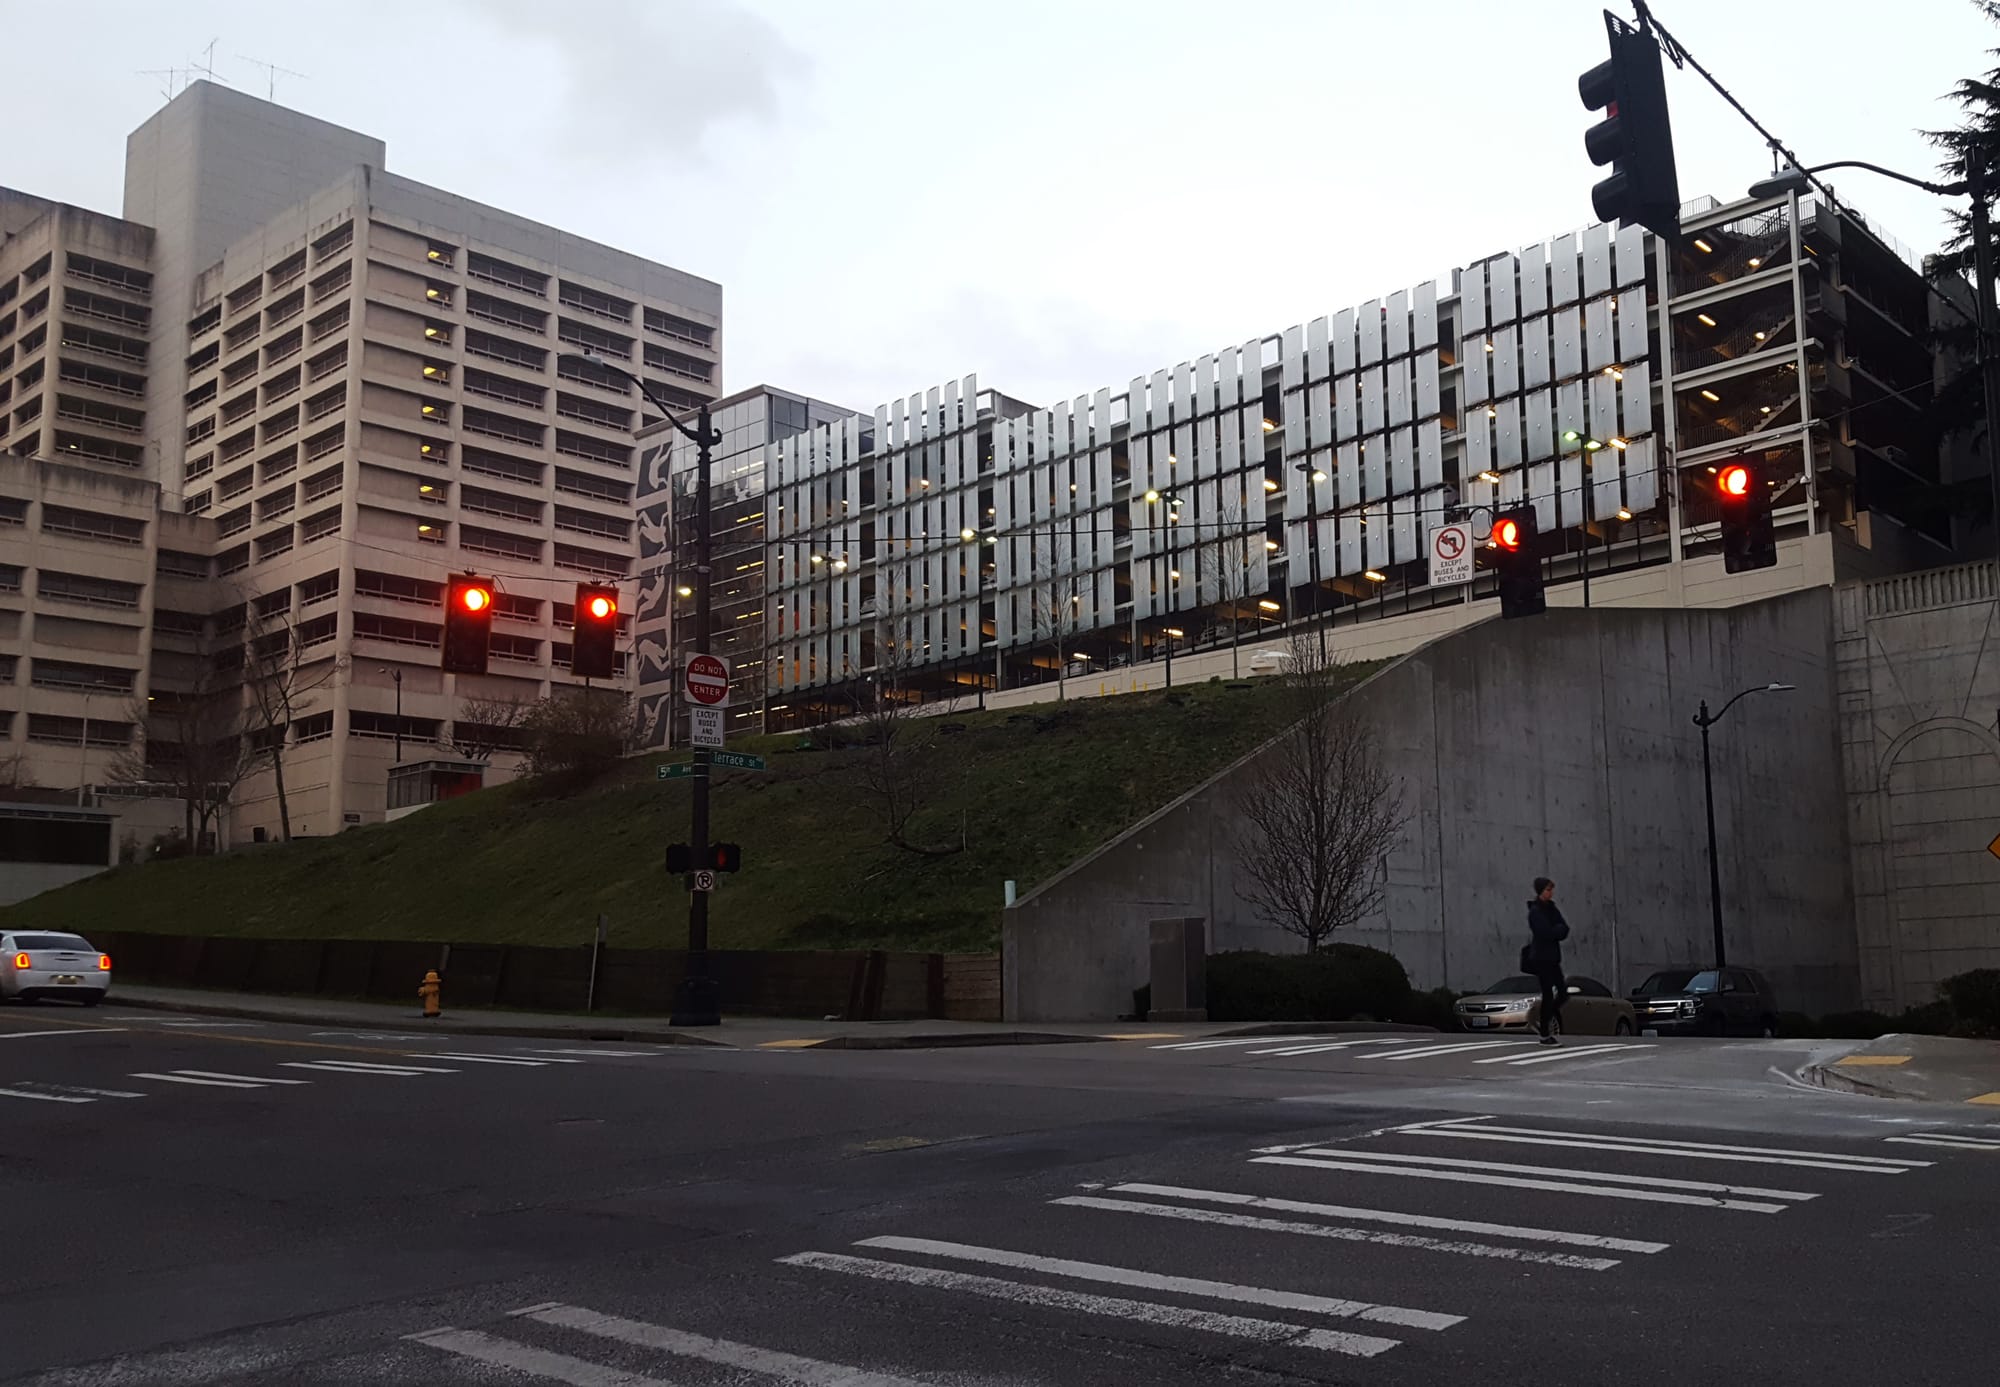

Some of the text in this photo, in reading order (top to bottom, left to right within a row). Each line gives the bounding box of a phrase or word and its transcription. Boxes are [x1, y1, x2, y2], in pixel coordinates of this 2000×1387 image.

[1440, 558, 1462, 568] EXCEPT
[1434, 567, 1454, 577] BUSES
[1437, 573, 1466, 583] BICYCLES
[694, 663, 722, 675] DO NOT
[694, 685, 721, 697] ENTER
[696, 710, 719, 719] EXCEPT
[694, 735, 721, 744] BICYCLES
[714, 751, 744, 766] Terrace
